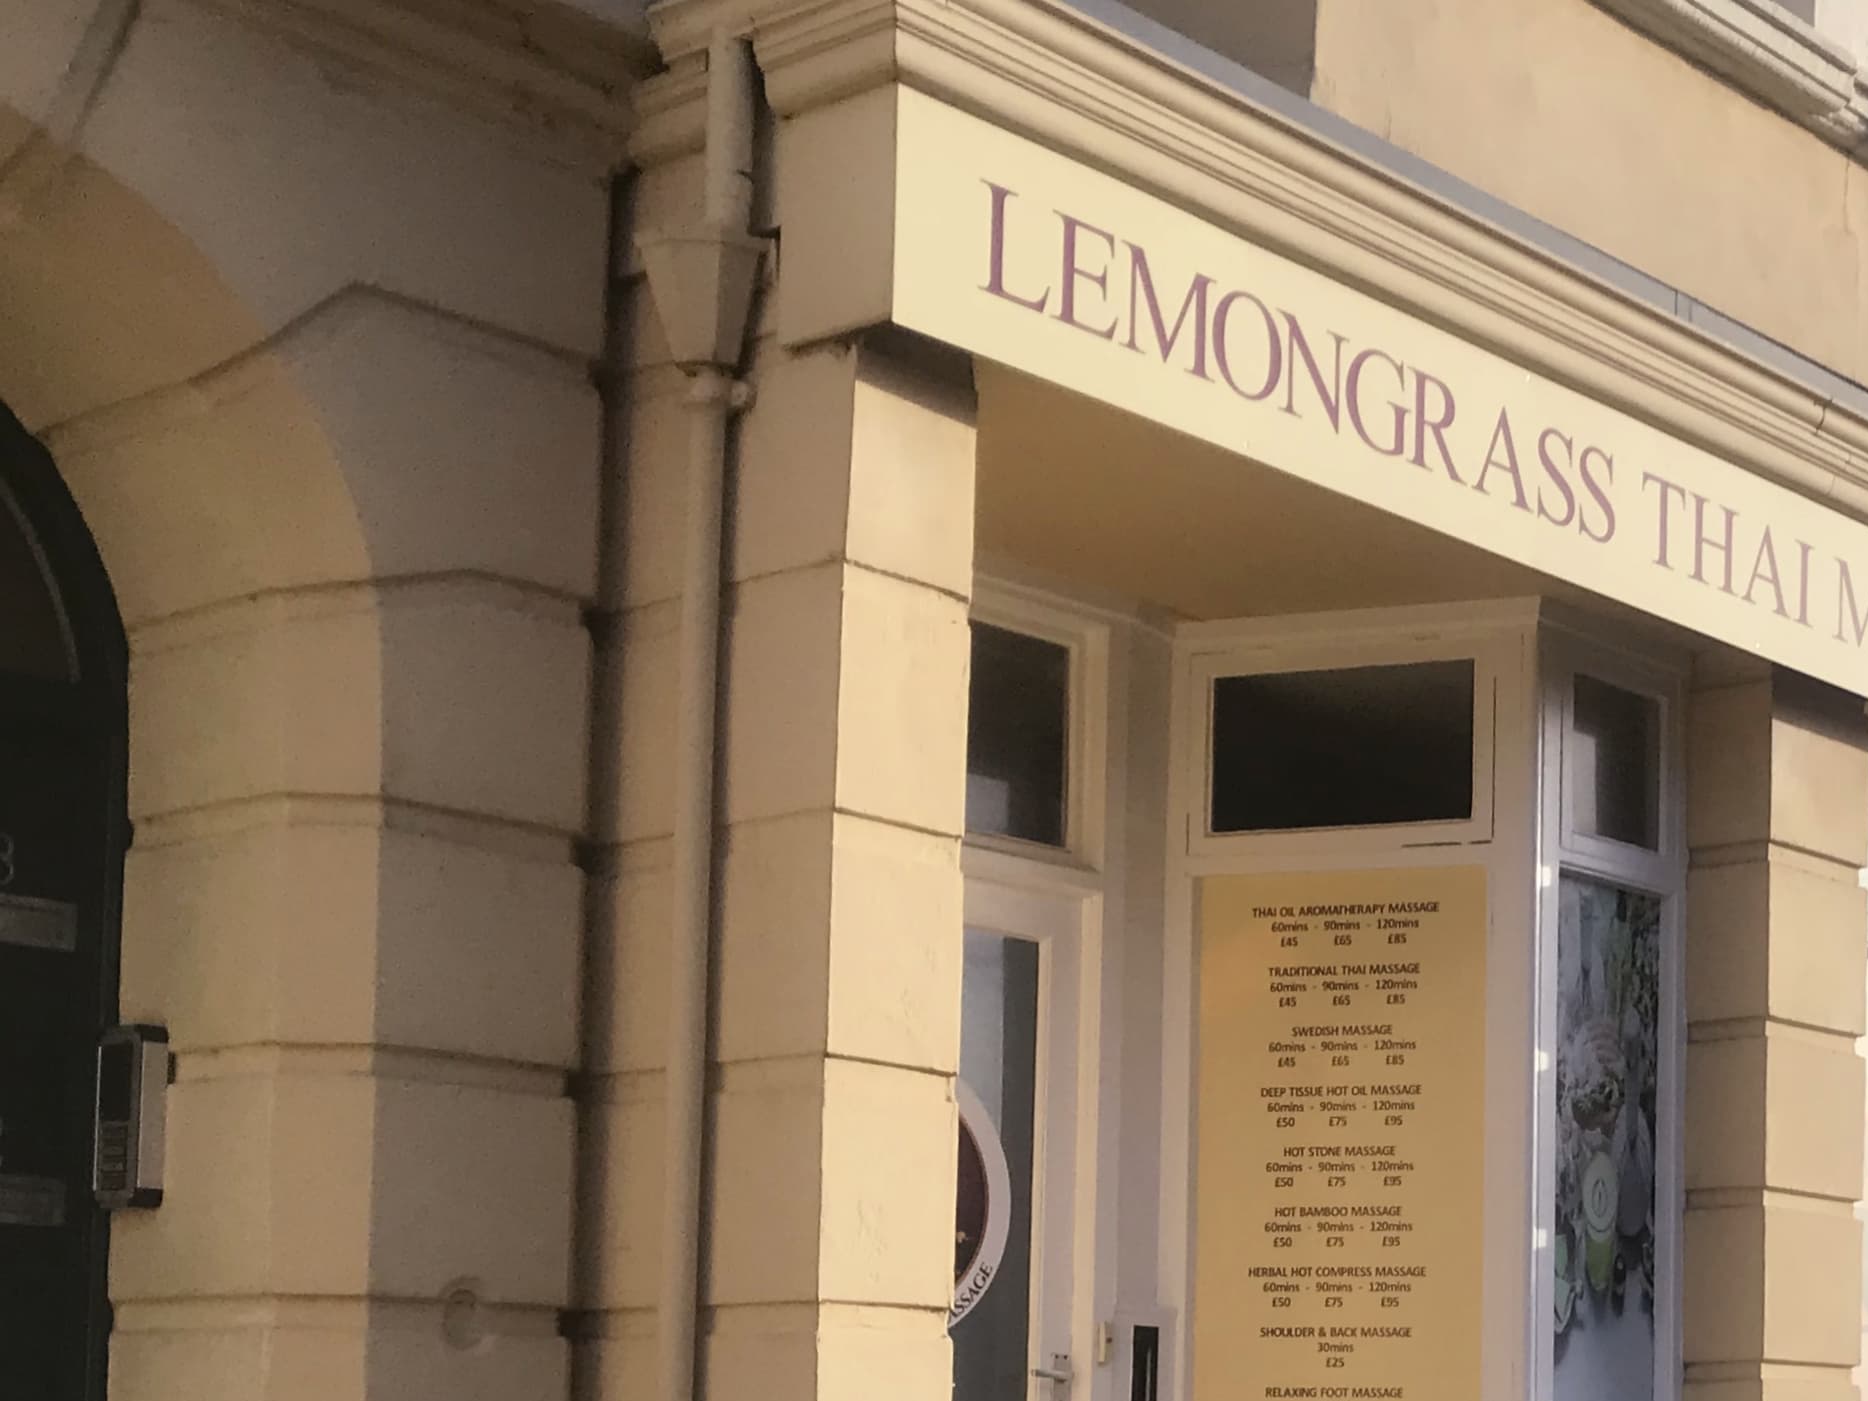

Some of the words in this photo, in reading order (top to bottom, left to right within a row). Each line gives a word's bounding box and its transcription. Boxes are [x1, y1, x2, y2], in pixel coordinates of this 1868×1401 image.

[978, 177, 1617, 544] LEMONGRASS
[1641, 471, 1817, 630] THAI
[1251, 906, 1278, 919] THAI
[1278, 906, 1296, 918] OIL
[1298, 903, 1386, 917] AROMATHERAPY
[1387, 901, 1441, 914] MASSAGE
[1270, 921, 1309, 933] 60mins
[1323, 920, 1361, 932] 90mins
[1376, 917, 1420, 930] 120mins
[1280, 936, 1299, 948] £45
[1333, 934, 1353, 947] £65
[1387, 932, 1408, 945] £85
[1267, 965, 1339, 978] TRADITIONAL
[1341, 964, 1367, 976] THAI
[1368, 962, 1421, 975] MASSAGE
[1269, 981, 1308, 993] 60mins
[1321, 980, 1360, 992] 90mins
[1375, 978, 1419, 991] 120mins
[1278, 996, 1297, 1009] £45
[1331, 994, 1352, 1007] £65
[1385, 993, 1406, 1005] £85
[1291, 1025, 1340, 1038] SWEDISH
[1341, 1023, 1393, 1036] MASSAGE
[1268, 1041, 1307, 1053] 60mins
[1320, 1040, 1359, 1052] 90mins
[1374, 1039, 1417, 1051] 120mins
[1277, 1056, 1297, 1069] £45
[1330, 1055, 1350, 1067] £65
[1385, 1054, 1405, 1066] £85
[1260, 1086, 1287, 1098] DEEP
[1288, 1085, 1324, 1098] TISSUE
[1326, 1085, 1350, 1097] HOT
[1350, 1085, 1369, 1097] OIL
[1370, 1083, 1422, 1096] MASSAGE
[1266, 1101, 1305, 1113] 60mins
[1319, 1101, 1358, 1112] 90mins
[1372, 1099, 1416, 1112] 120mins
[1275, 1116, 1296, 1129] £50
[1328, 1115, 1348, 1128] £75
[1383, 1114, 1404, 1127] £95
[1283, 1146, 1306, 1158] HOT
[1307, 1145, 1343, 1158] STONE
[1344, 1145, 1397, 1157] MASSAGE
[1265, 1161, 1304, 1173] 60mins
[1317, 1161, 1356, 1173] 90mins
[1371, 1159, 1415, 1172] 120mins
[1273, 1176, 1295, 1189] £50
[1327, 1175, 1347, 1188] £75
[1382, 1175, 1403, 1187] £95
[1274, 1206, 1297, 1218] HOT
[1298, 1206, 1349, 1218] BAMBOO
[1350, 1205, 1403, 1217] MASSAGE
[1263, 1221, 1303, 1233] 60mins
[1316, 1221, 1355, 1233] 90mins
[1369, 1220, 1414, 1233] 120mins
[1272, 1236, 1293, 1248] £50
[1325, 1236, 1345, 1248] £75
[1381, 1235, 1401, 1248] £95
[1247, 1266, 1289, 1279] HERBAL
[1290, 1266, 1313, 1278] HOT
[1314, 1265, 1373, 1278] COMPRESS
[1374, 1265, 1427, 1278] MASSAGE
[1262, 1281, 1301, 1293] 60mins
[1315, 1281, 1354, 1293] 90mins
[1368, 1281, 1412, 1293] 120mins
[1271, 1296, 1292, 1308] £50
[1324, 1296, 1344, 1309] £75
[1380, 1296, 1400, 1308] £95
[1259, 1326, 1316, 1339] SHOULDER
[1317, 1326, 1327, 1338] &
[1329, 1326, 1358, 1338] BACK
[1359, 1326, 1413, 1339] MASSAGE
[1316, 1341, 1355, 1353] 30mins
[1325, 1356, 1345, 1369] £25
[1264, 1386, 1318, 1399] RELAXING
[1319, 1386, 1350, 1398] FOOT
[1351, 1386, 1404, 1400] MASSAGE
